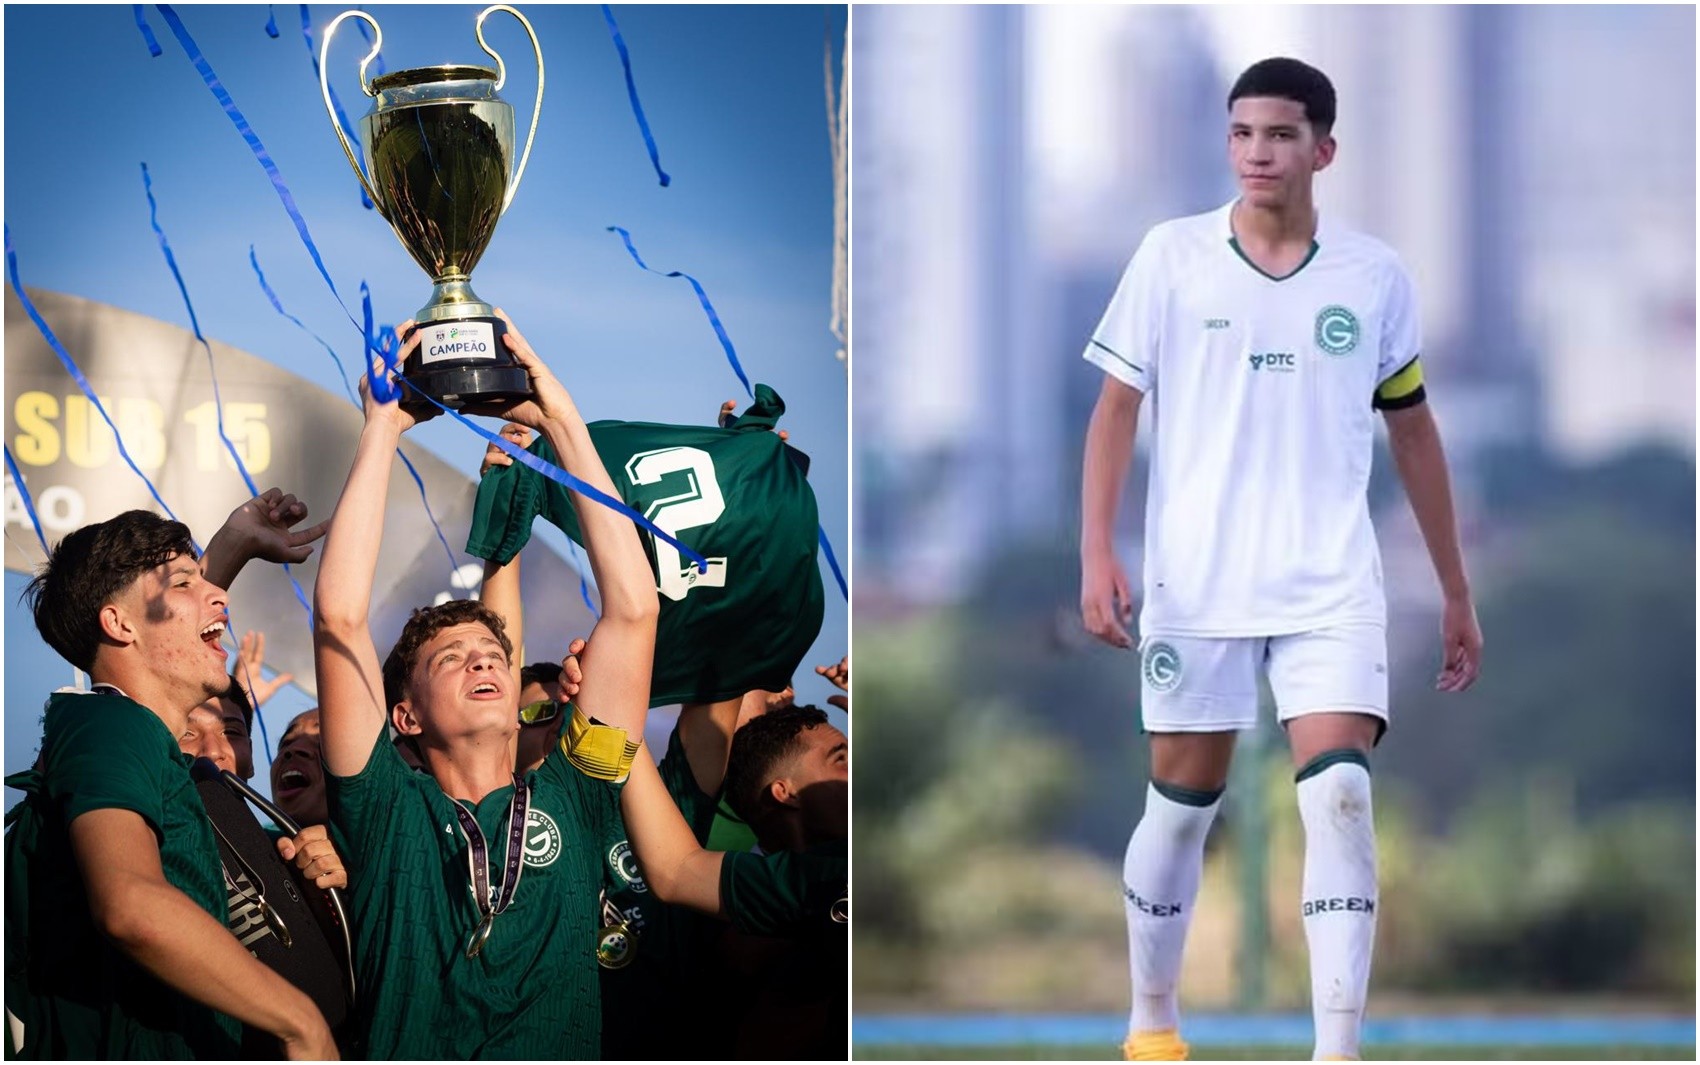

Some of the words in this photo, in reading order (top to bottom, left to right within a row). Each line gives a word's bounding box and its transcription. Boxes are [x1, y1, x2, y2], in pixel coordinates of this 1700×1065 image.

[429, 340, 487, 356] CAMPEÃO
[1266, 353, 1295, 366] DTC
[14, 391, 166, 470] SUB
[184, 400, 271, 475] 15
[625, 446, 728, 602] 2
[539, 816, 558, 840] CLUBE
[623, 906, 642, 923] TC
